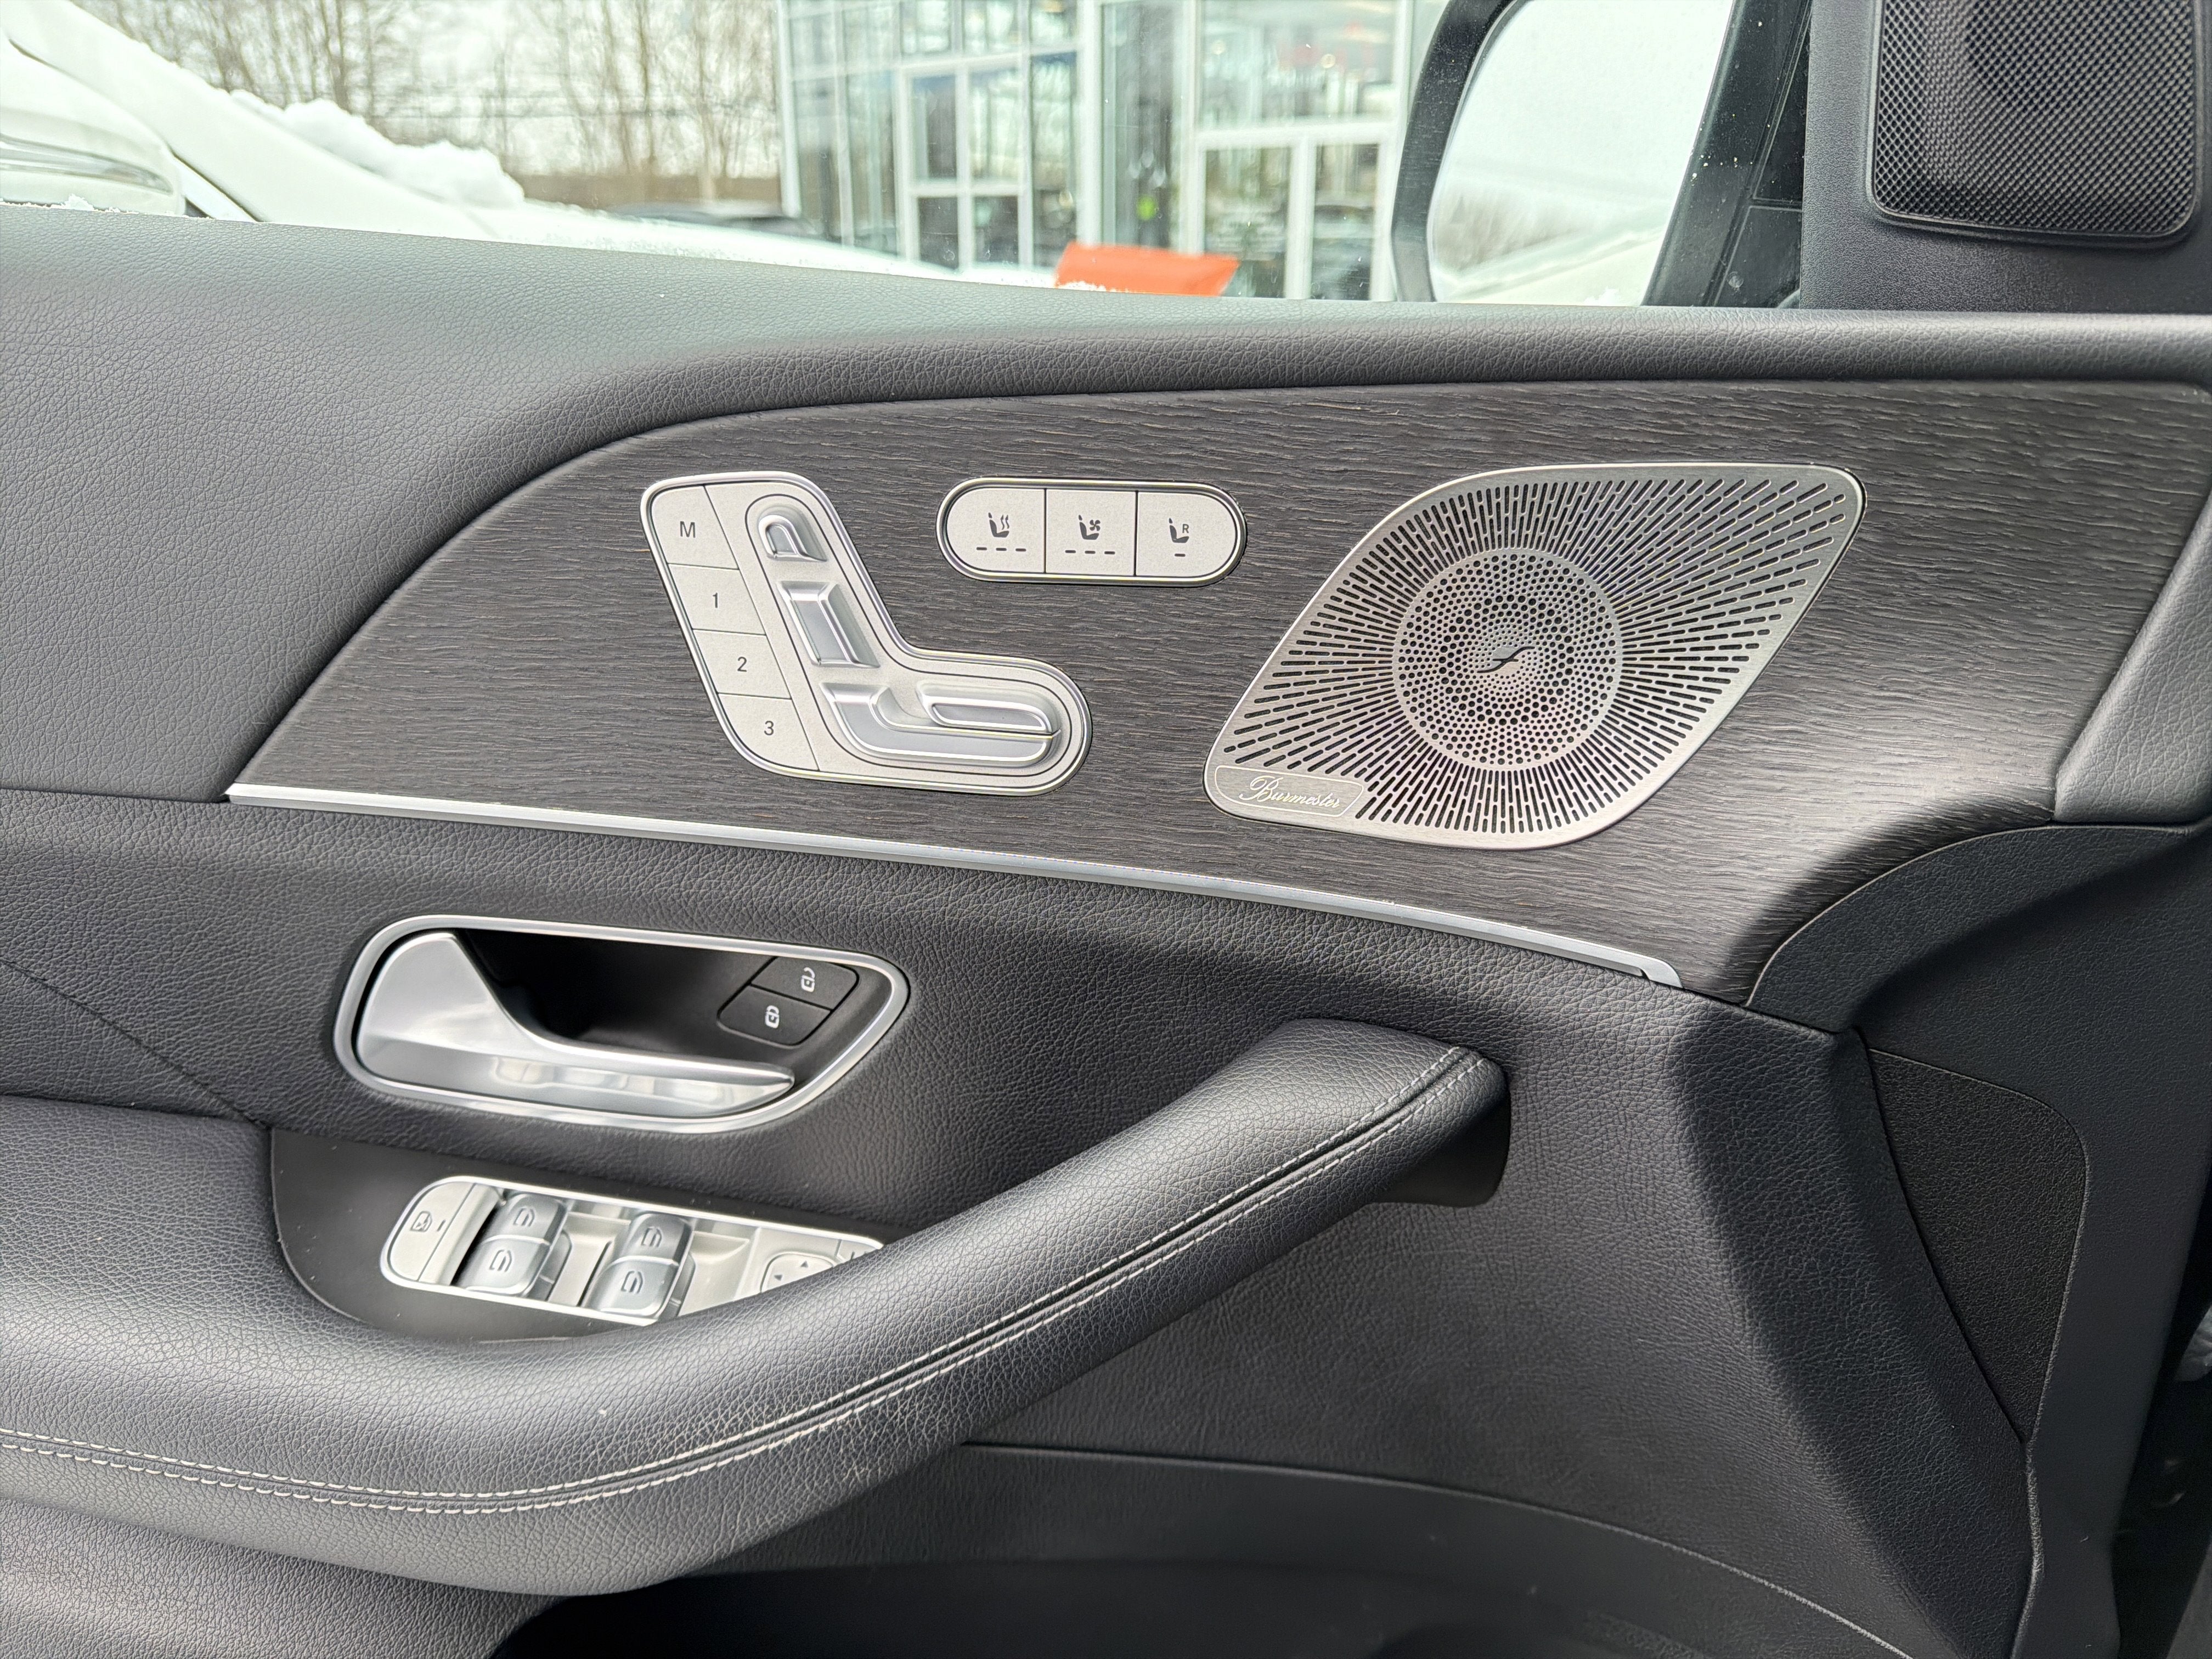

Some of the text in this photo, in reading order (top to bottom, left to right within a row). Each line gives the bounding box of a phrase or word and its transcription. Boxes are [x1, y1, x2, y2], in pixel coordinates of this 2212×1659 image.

[679, 521, 696, 538] M
[1182, 523, 1190, 534] R
[712, 592, 719, 608] 1
[737, 657, 748, 673] 2
[763, 720, 775, 736] 3
[1238, 775, 1342, 809] Burmester
